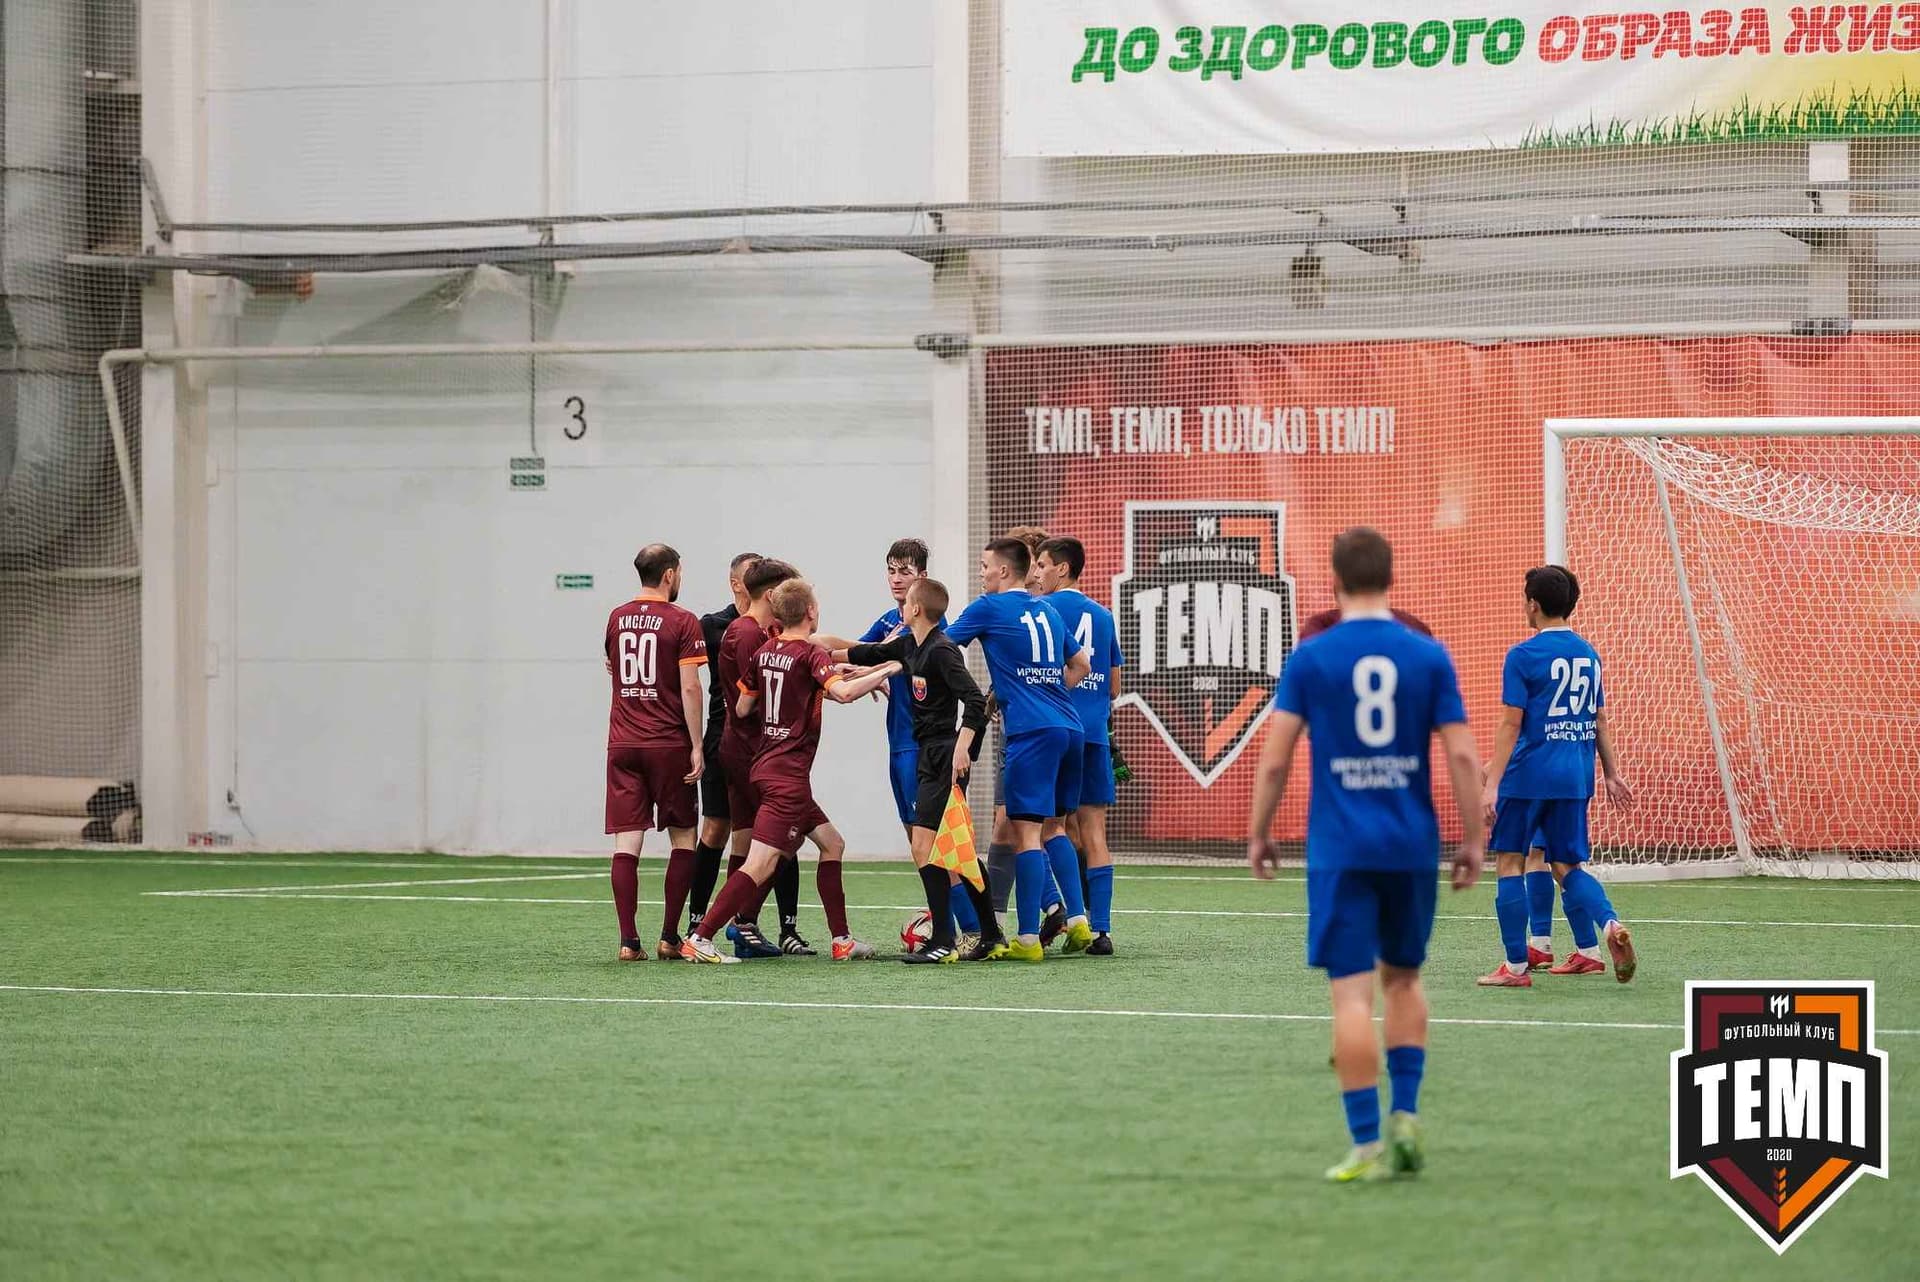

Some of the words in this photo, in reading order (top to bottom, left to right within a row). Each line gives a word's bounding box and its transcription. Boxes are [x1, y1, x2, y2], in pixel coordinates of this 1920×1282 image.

[1071, 26, 1160, 84] ДО
[1167, 17, 1526, 83] ЗДОРОВОГО
[1537, 8, 1772, 64] ОБРАЗА
[1783, 2, 1920, 56] ЖИЗ
[564, 396, 587, 440] 3
[1110, 406, 1190, 459] ТЕМП,
[1200, 404, 1307, 454] ТОЛЬКО
[1314, 406, 1395, 454] ТЕМП!
[618, 615, 663, 631] КИСЕЛЕВ
[1020, 611, 1055, 662] 11
[1073, 613, 1095, 658] 4
[1133, 581, 1282, 679] ТЕМП
[618, 632, 658, 686] 60
[1352, 654, 1399, 748] 8
